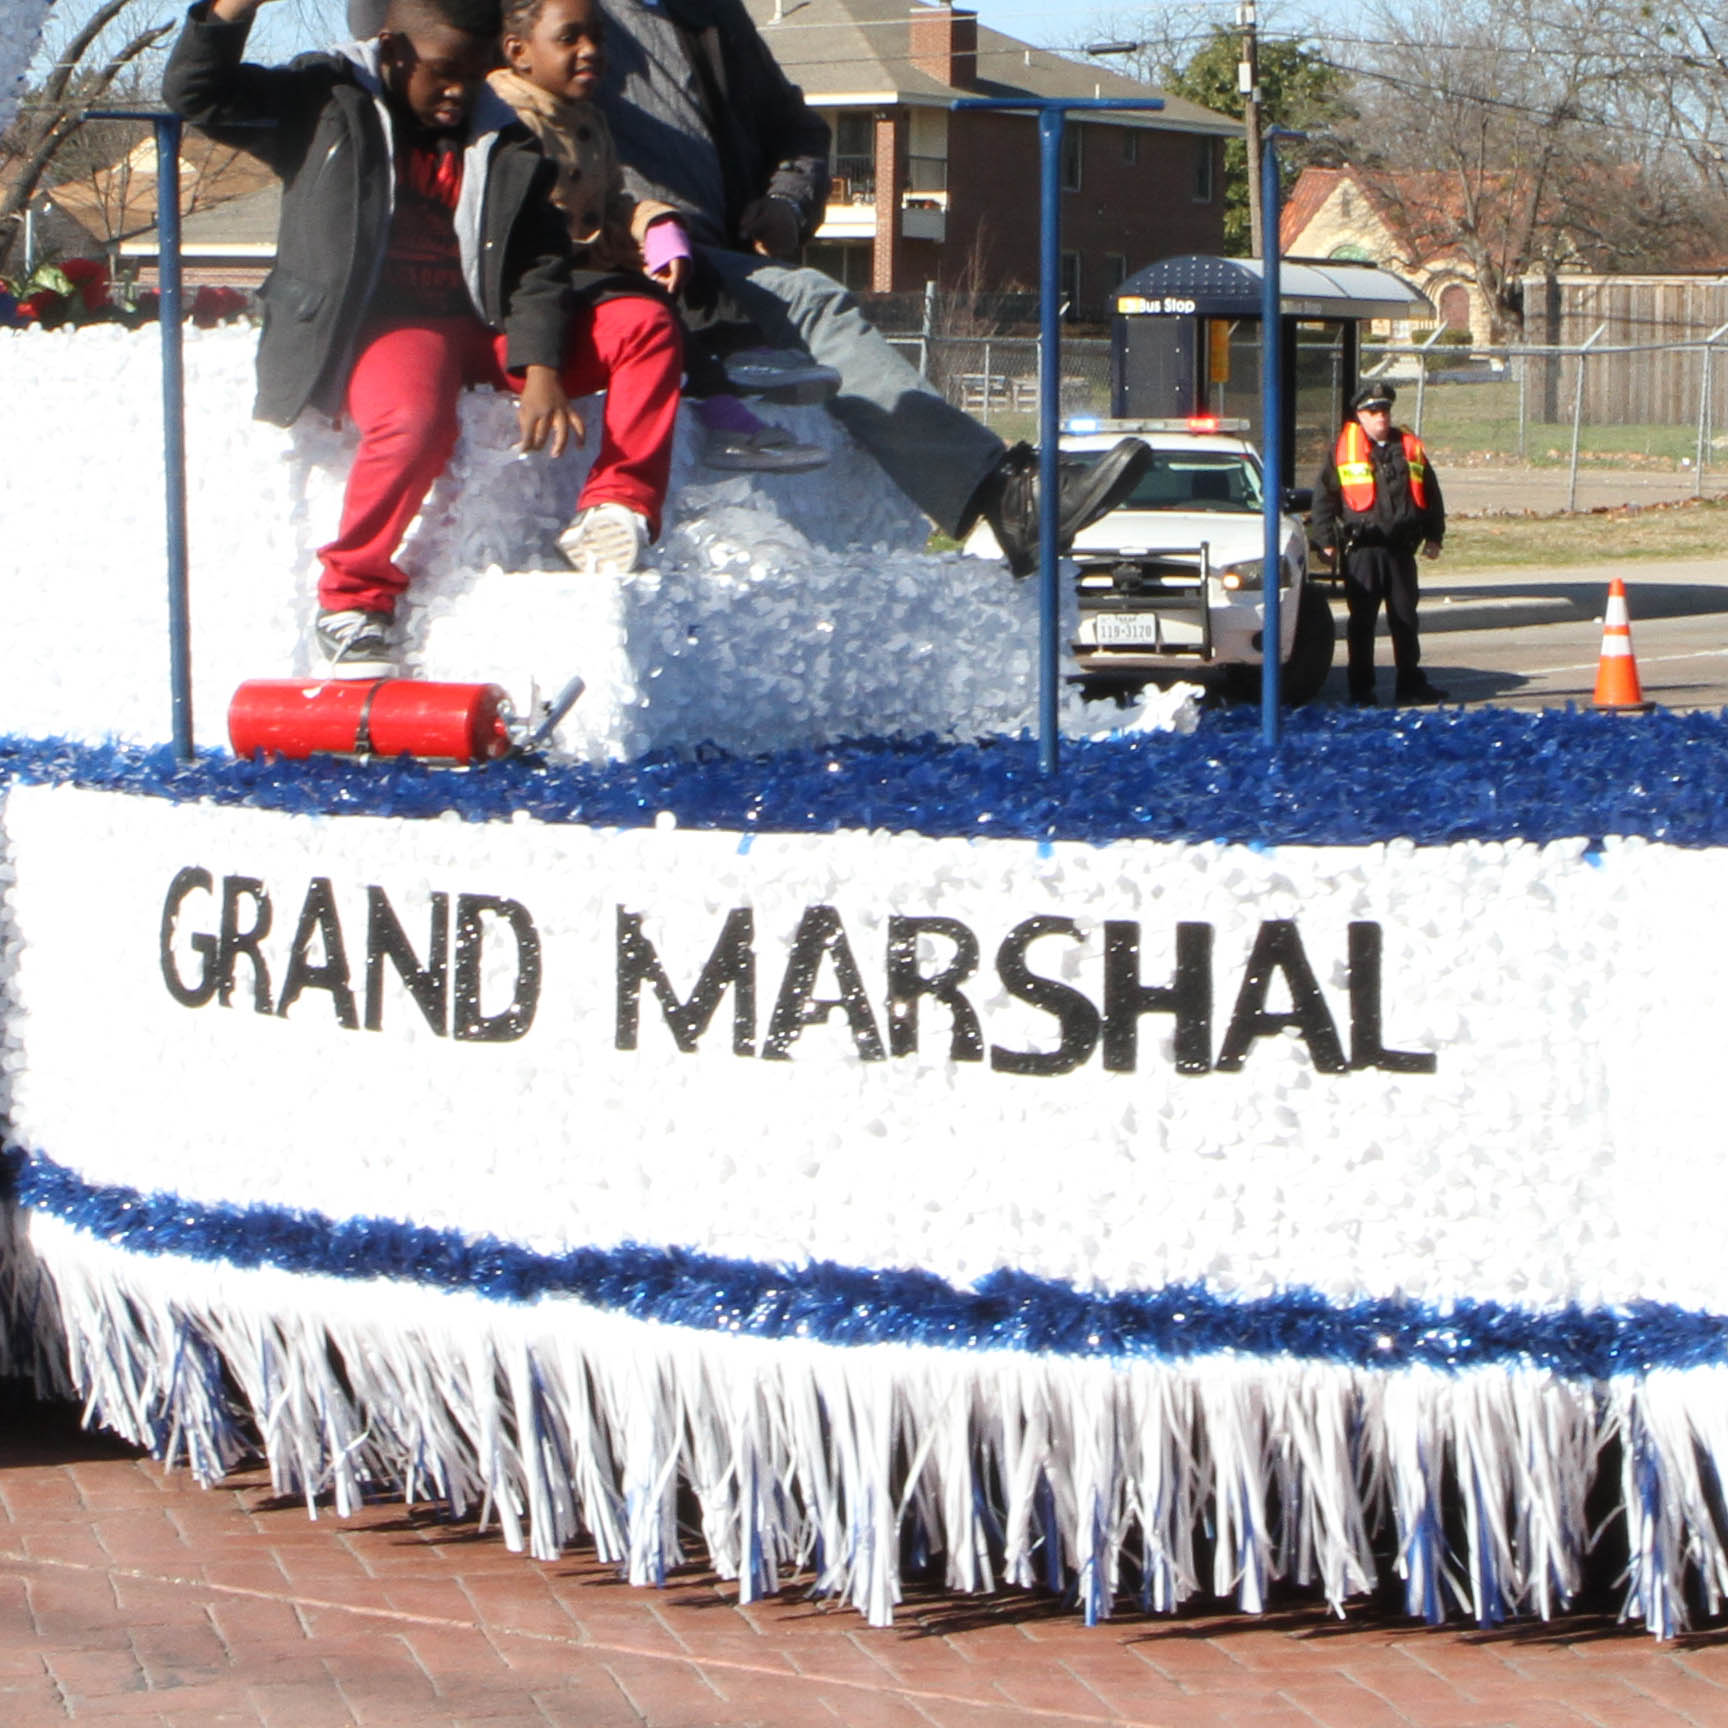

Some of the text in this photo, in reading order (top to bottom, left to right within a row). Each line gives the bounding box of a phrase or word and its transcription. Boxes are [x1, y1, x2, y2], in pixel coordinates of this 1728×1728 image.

[1138, 297, 1195, 314] Bus Stop
[158, 866, 1439, 1077] GRAND MARSHAL
